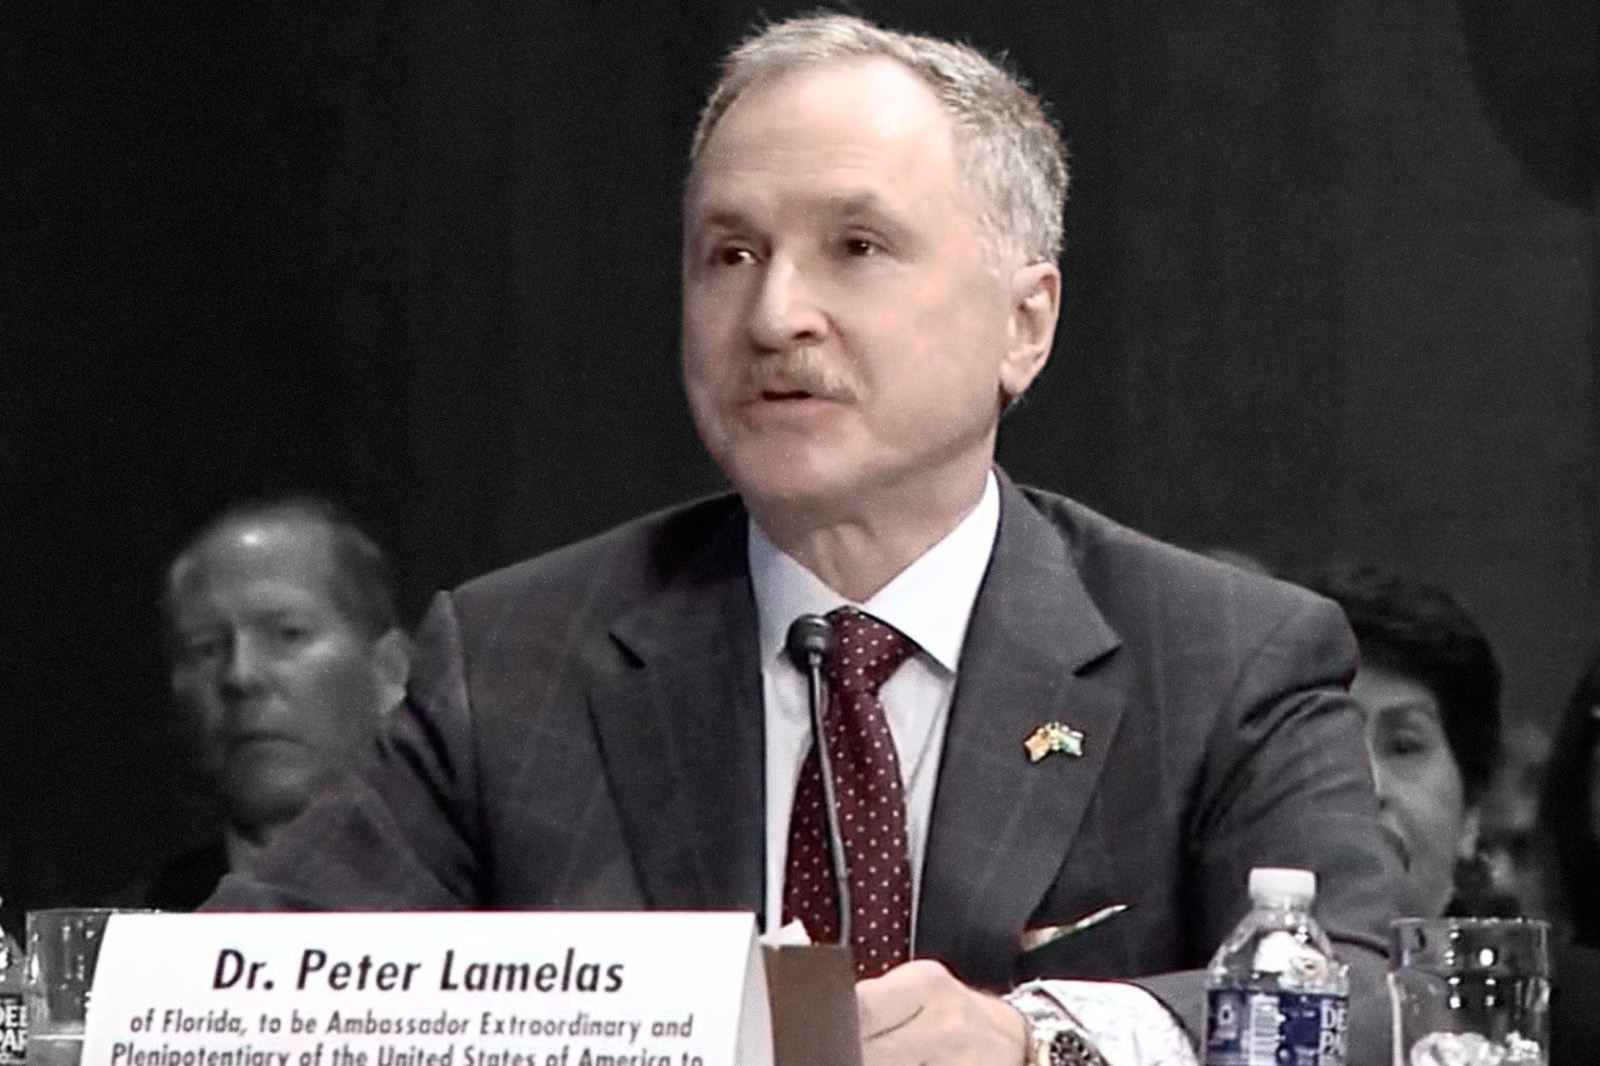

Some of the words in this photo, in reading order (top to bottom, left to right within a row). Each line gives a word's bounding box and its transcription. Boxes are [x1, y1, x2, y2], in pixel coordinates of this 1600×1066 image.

[212, 948, 274, 991] Dr.
[296, 948, 422, 992] Peter
[439, 947, 625, 993] Lamelas
[130, 1007, 154, 1034] of
[162, 1008, 247, 1037] Florida,
[259, 1013, 282, 1034] to
[290, 1009, 317, 1035] be
[325, 1009, 470, 1036] Ambassador
[479, 1011, 642, 1044] Extraordinary
[651, 1013, 694, 1038] and
[110, 1042, 291, 1066] Plenipotentiary
[299, 1043, 324, 1066] of
[331, 1044, 369, 1066] the
[377, 1044, 454, 1066] United
[463, 1045, 536, 1066] States
[545, 1045, 570, 1066] of
[577, 1047, 672, 1066] America
[681, 1051, 704, 1066] to
